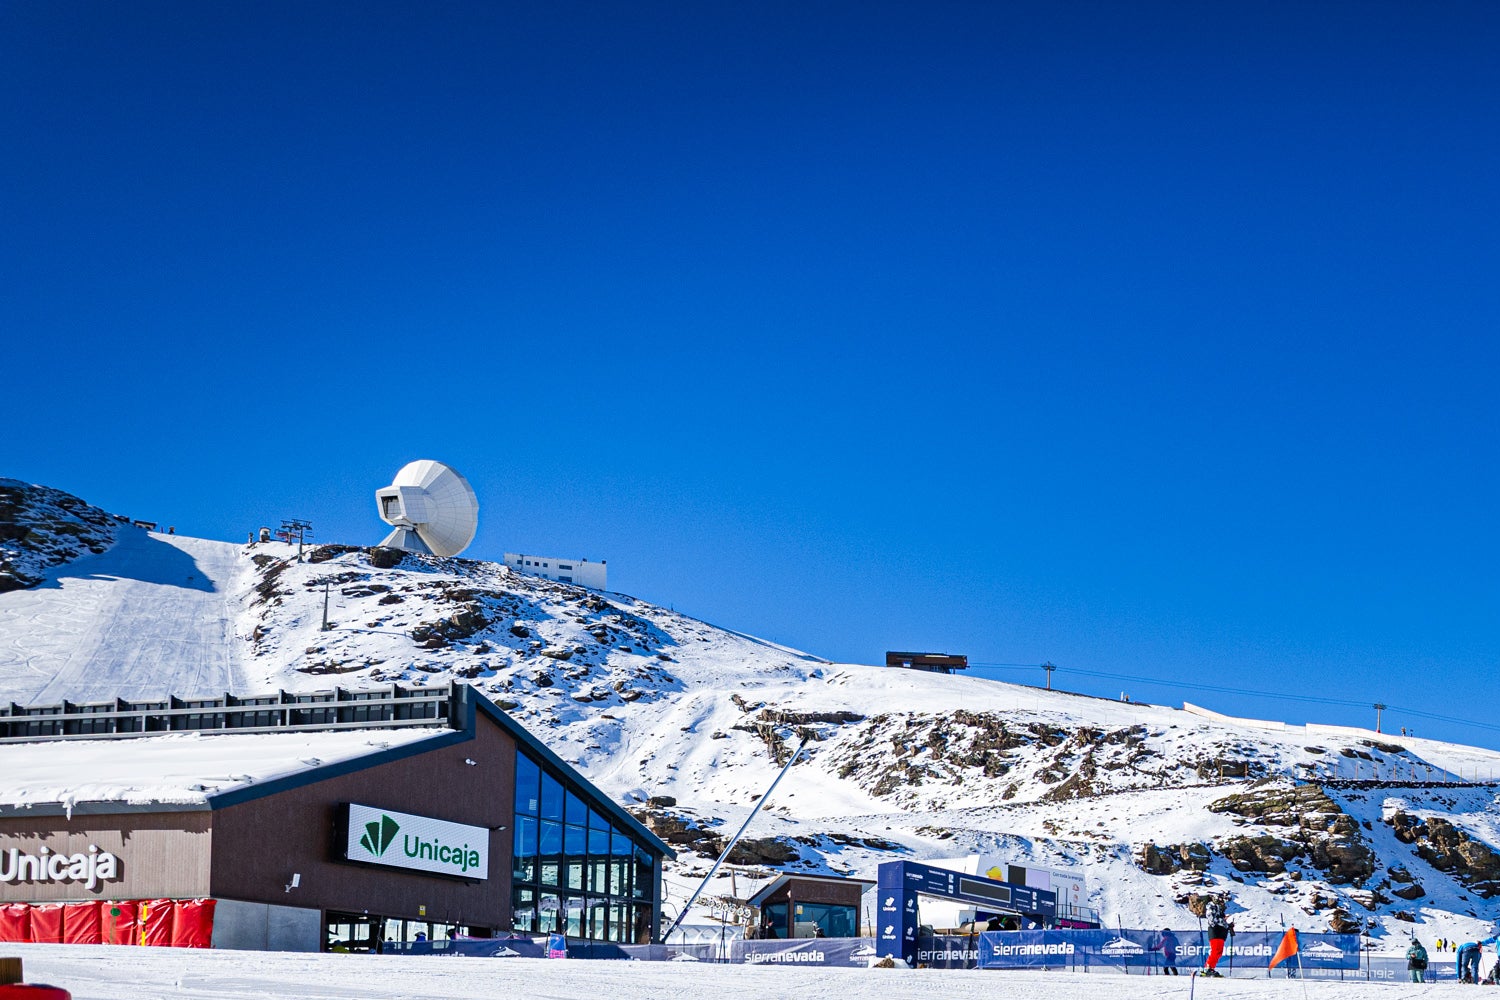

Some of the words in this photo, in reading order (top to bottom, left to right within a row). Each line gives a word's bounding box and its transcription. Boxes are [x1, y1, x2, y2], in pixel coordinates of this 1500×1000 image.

[403, 833, 480, 873] Unicaja
[0, 845, 118, 890] Unicaja
[744, 950, 825, 963] sierranevada
[993, 941, 1074, 956] sierranevada
